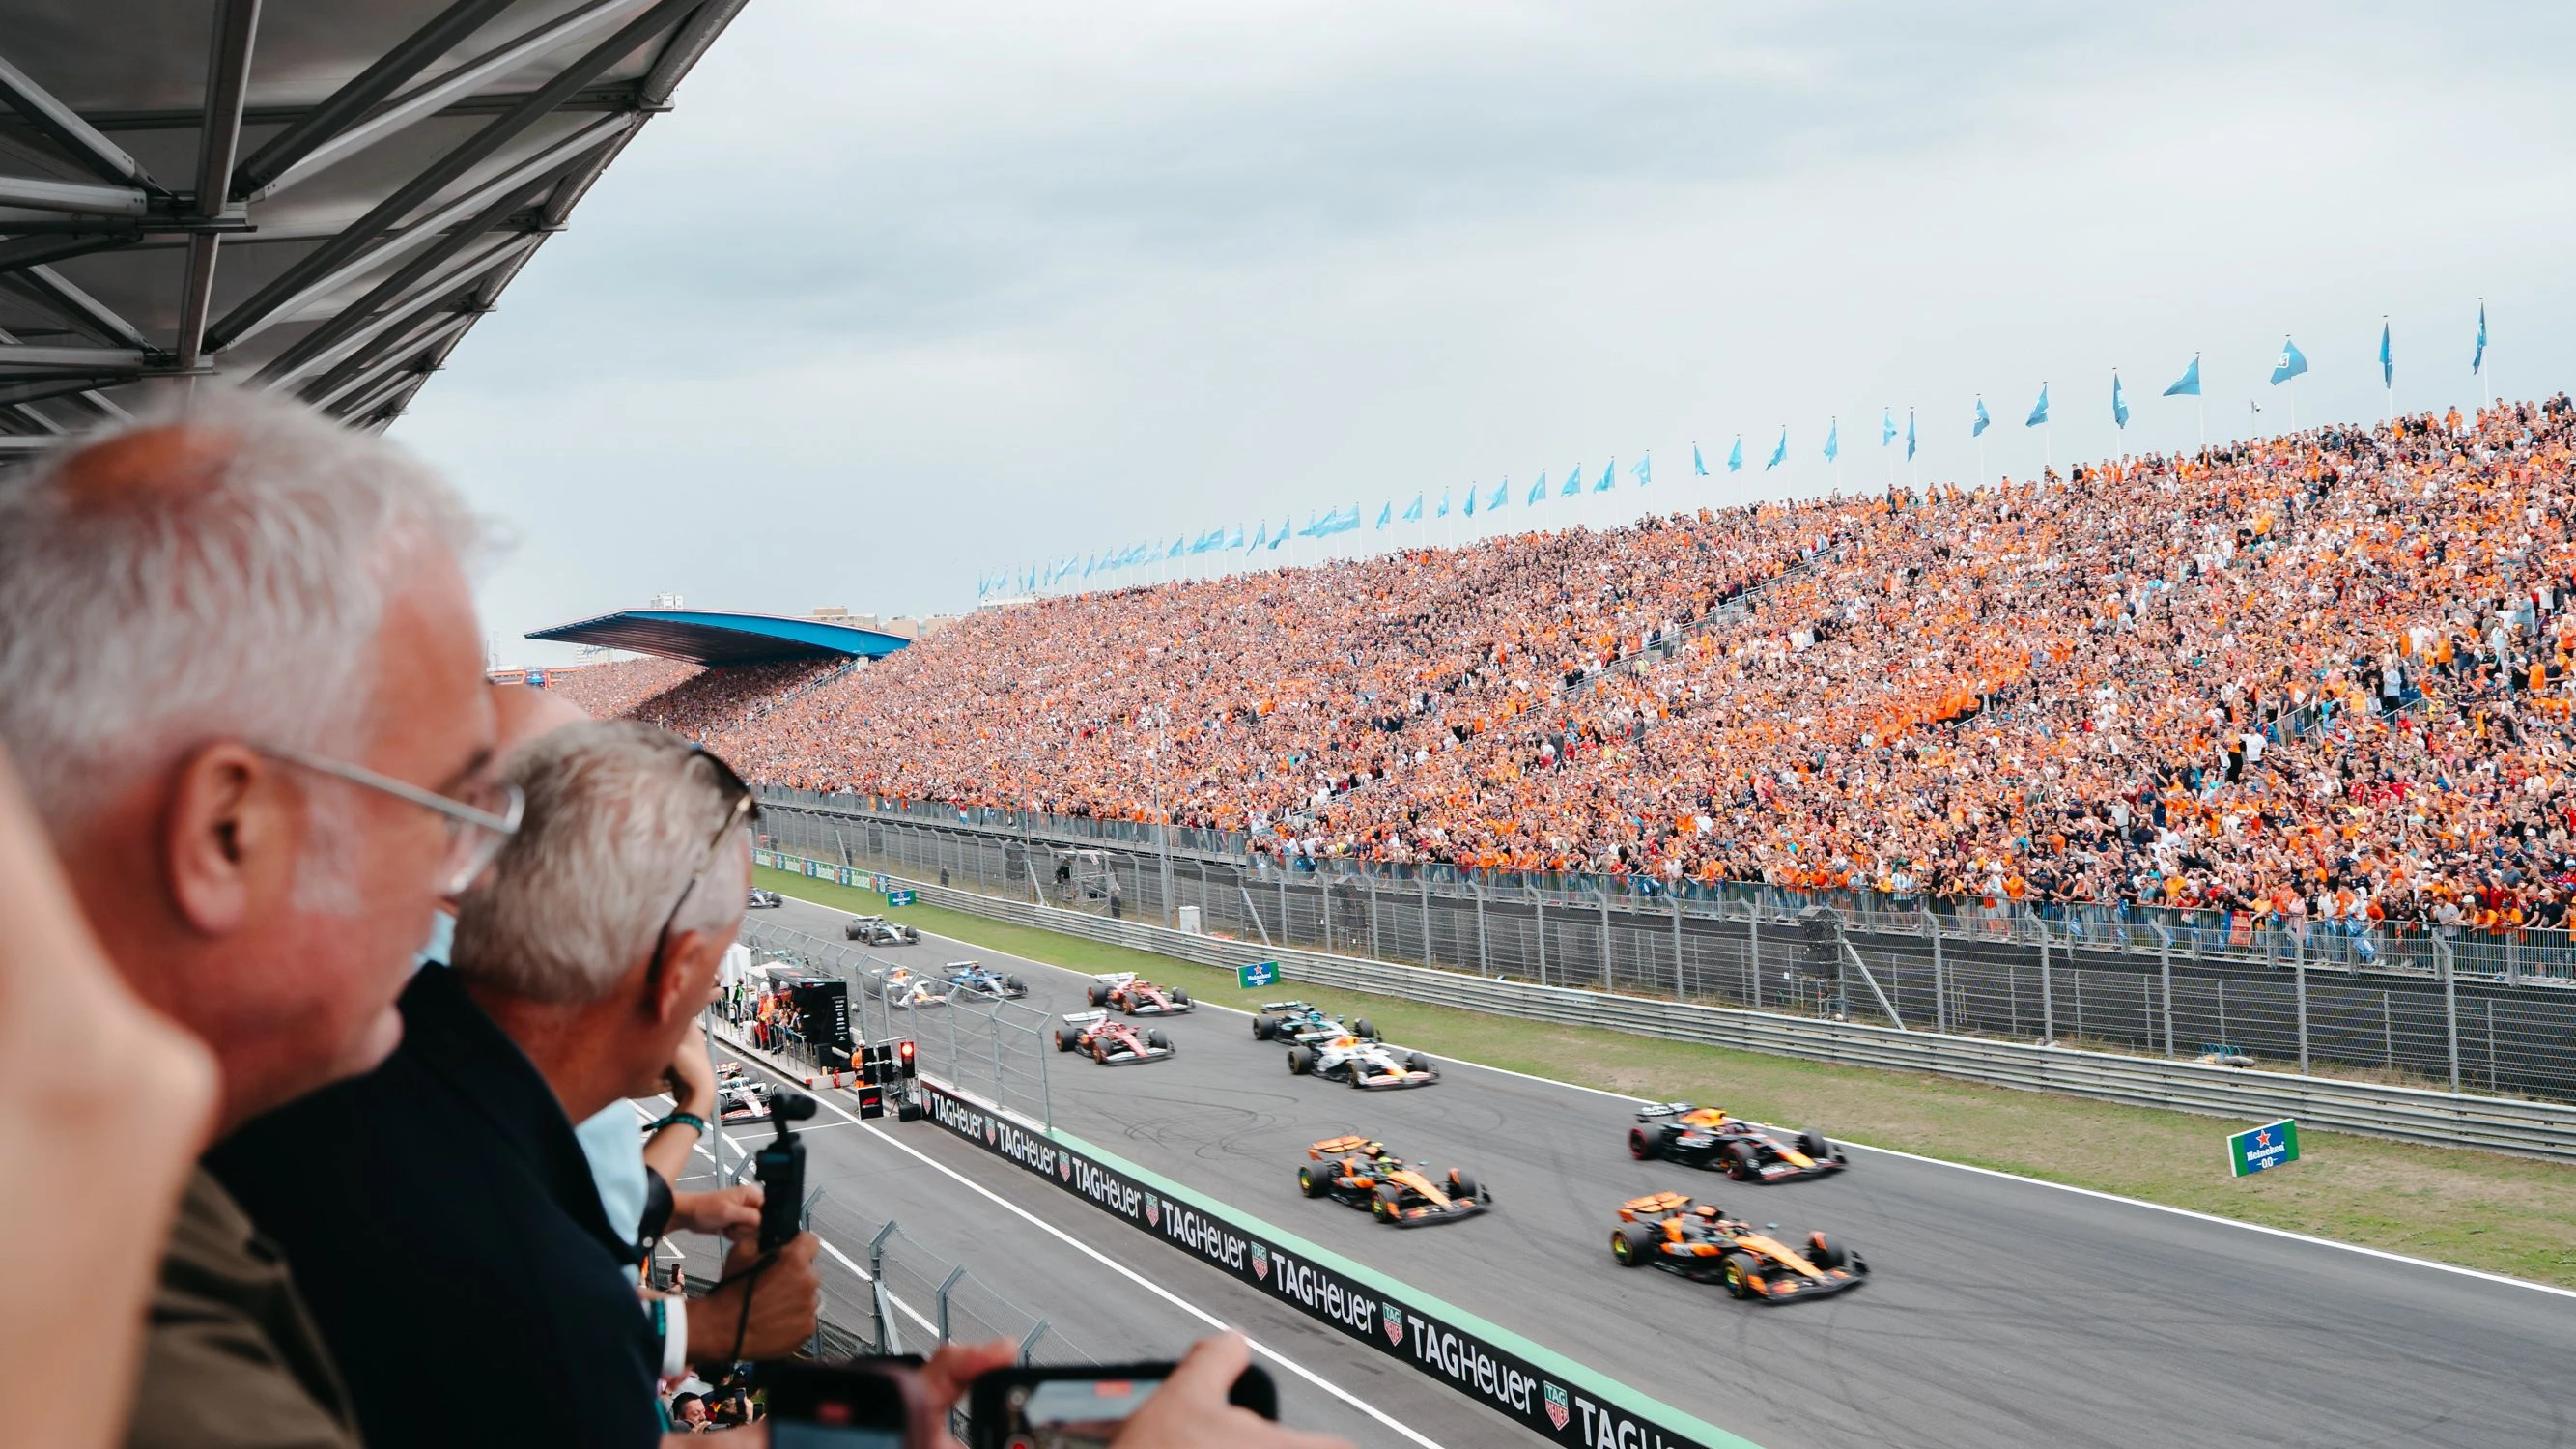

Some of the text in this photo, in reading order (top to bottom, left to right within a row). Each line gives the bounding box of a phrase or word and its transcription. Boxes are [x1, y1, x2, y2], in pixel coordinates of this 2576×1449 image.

[997, 1122, 1056, 1176] TAGHeuer
[2247, 1145, 2285, 1161] Heineken
[1072, 1157, 1141, 1219] TAGHeuer
[1162, 1200, 1246, 1270] TAGHeuer
[1252, 1244, 1266, 1260] TAG
[1272, 1251, 1376, 1334] TAGHeuer
[1384, 1305, 1401, 1324] TAG
[1408, 1315, 1536, 1414] TAGHeuer
[1545, 1384, 1566, 1405] TAG
[1545, 1401, 1568, 1426] HEUER
